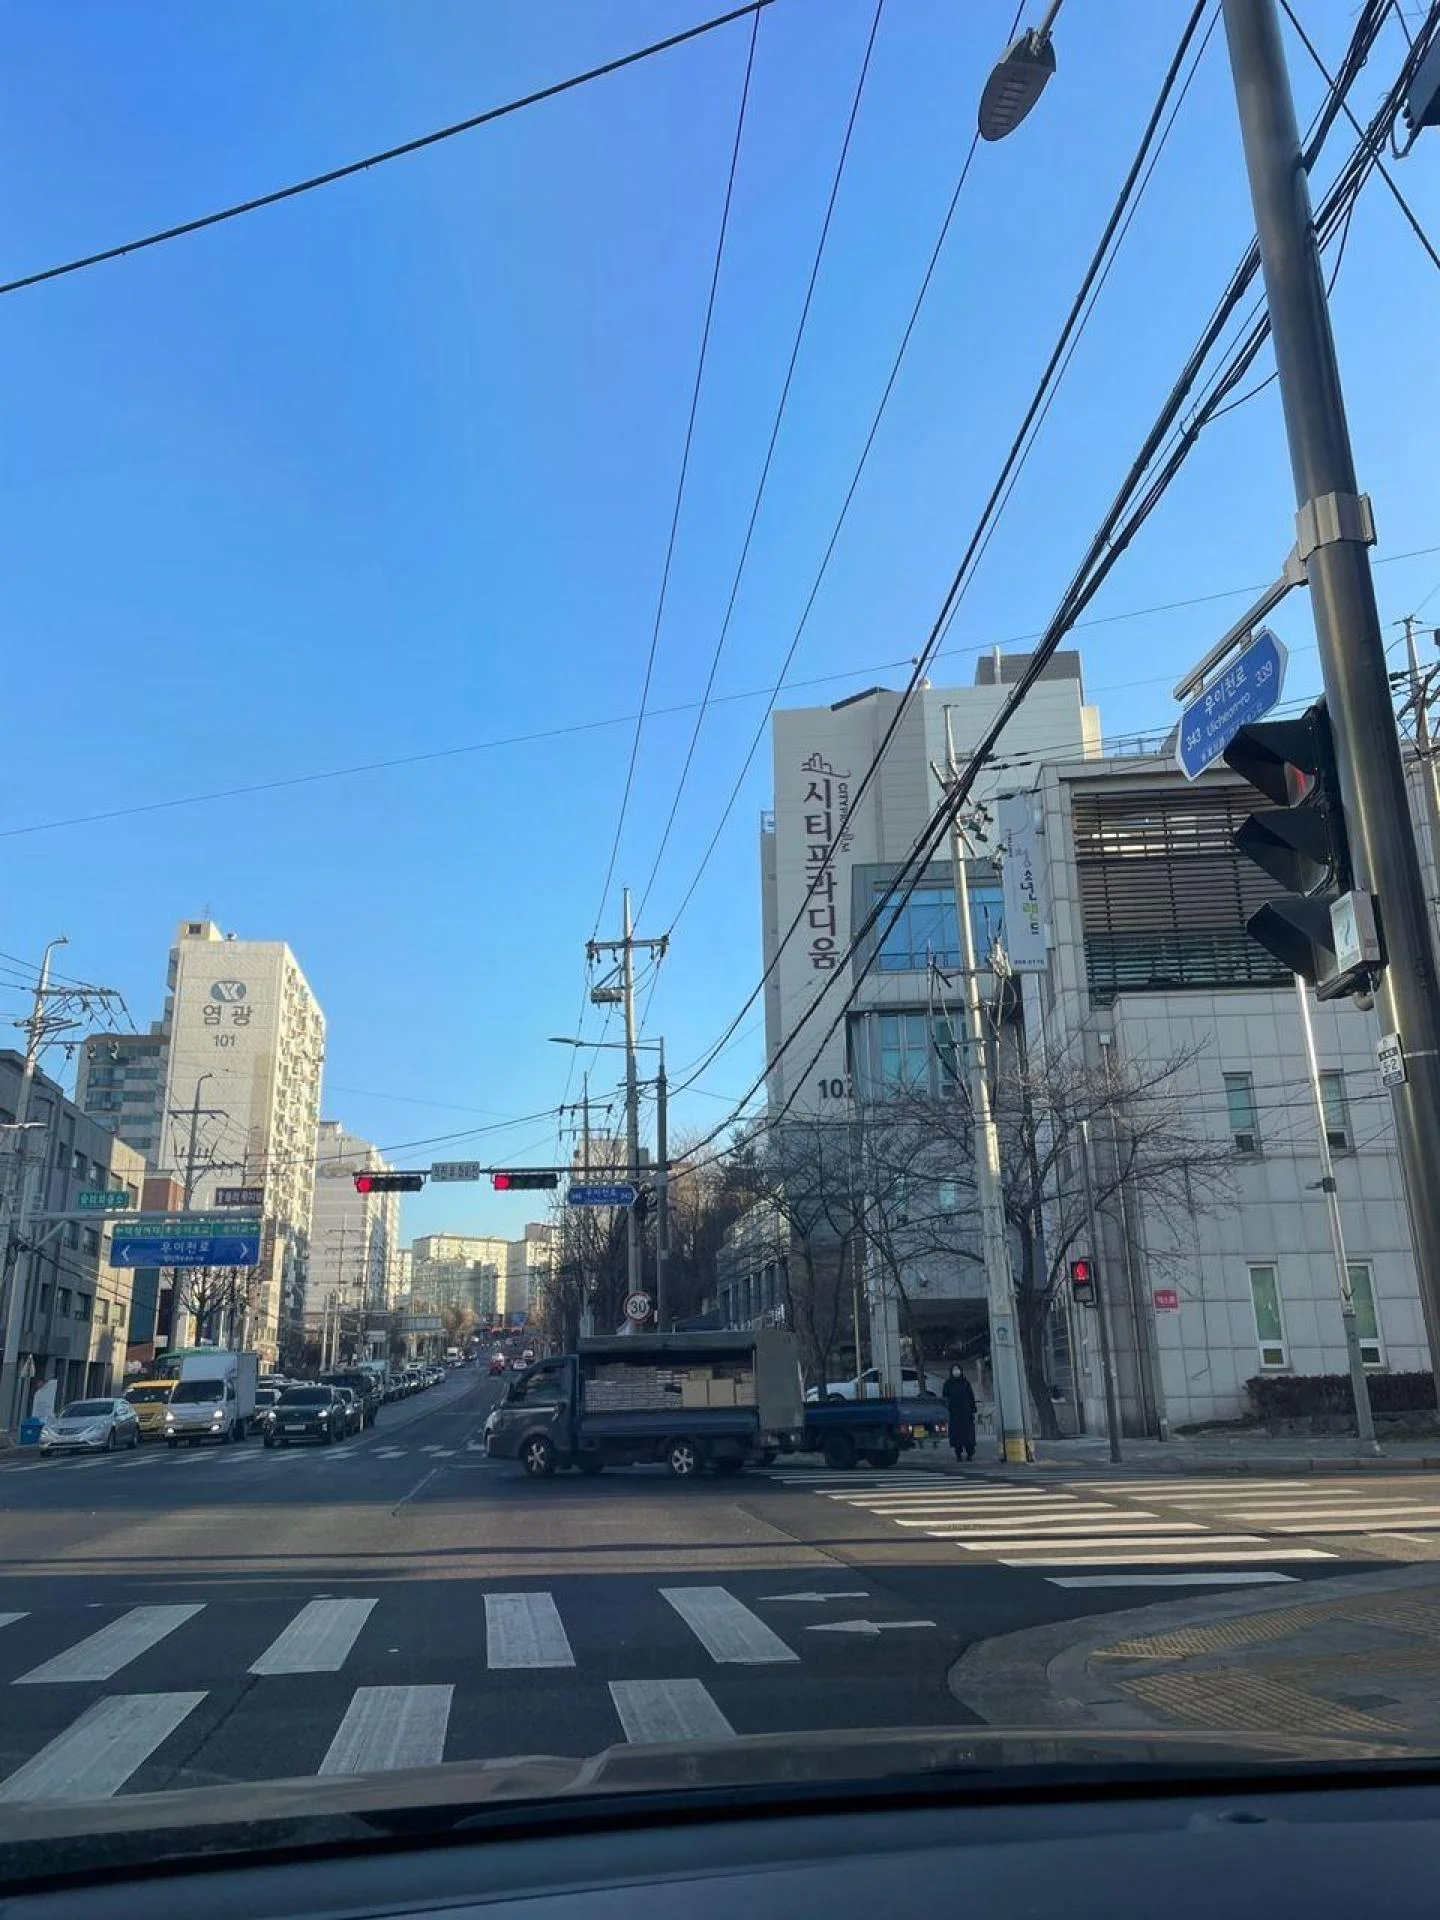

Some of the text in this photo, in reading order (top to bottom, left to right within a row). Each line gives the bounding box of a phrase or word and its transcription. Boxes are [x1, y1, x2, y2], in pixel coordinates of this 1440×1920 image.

[1255, 660, 1273, 688] 339
[1205, 665, 1247, 716] 우이천로
[804, 778, 840, 970] 시티프라디움
[213, 1034, 235, 1047] 101
[162, 1240, 209, 1255] 우이천로
[631, 1300, 646, 1313] 30
